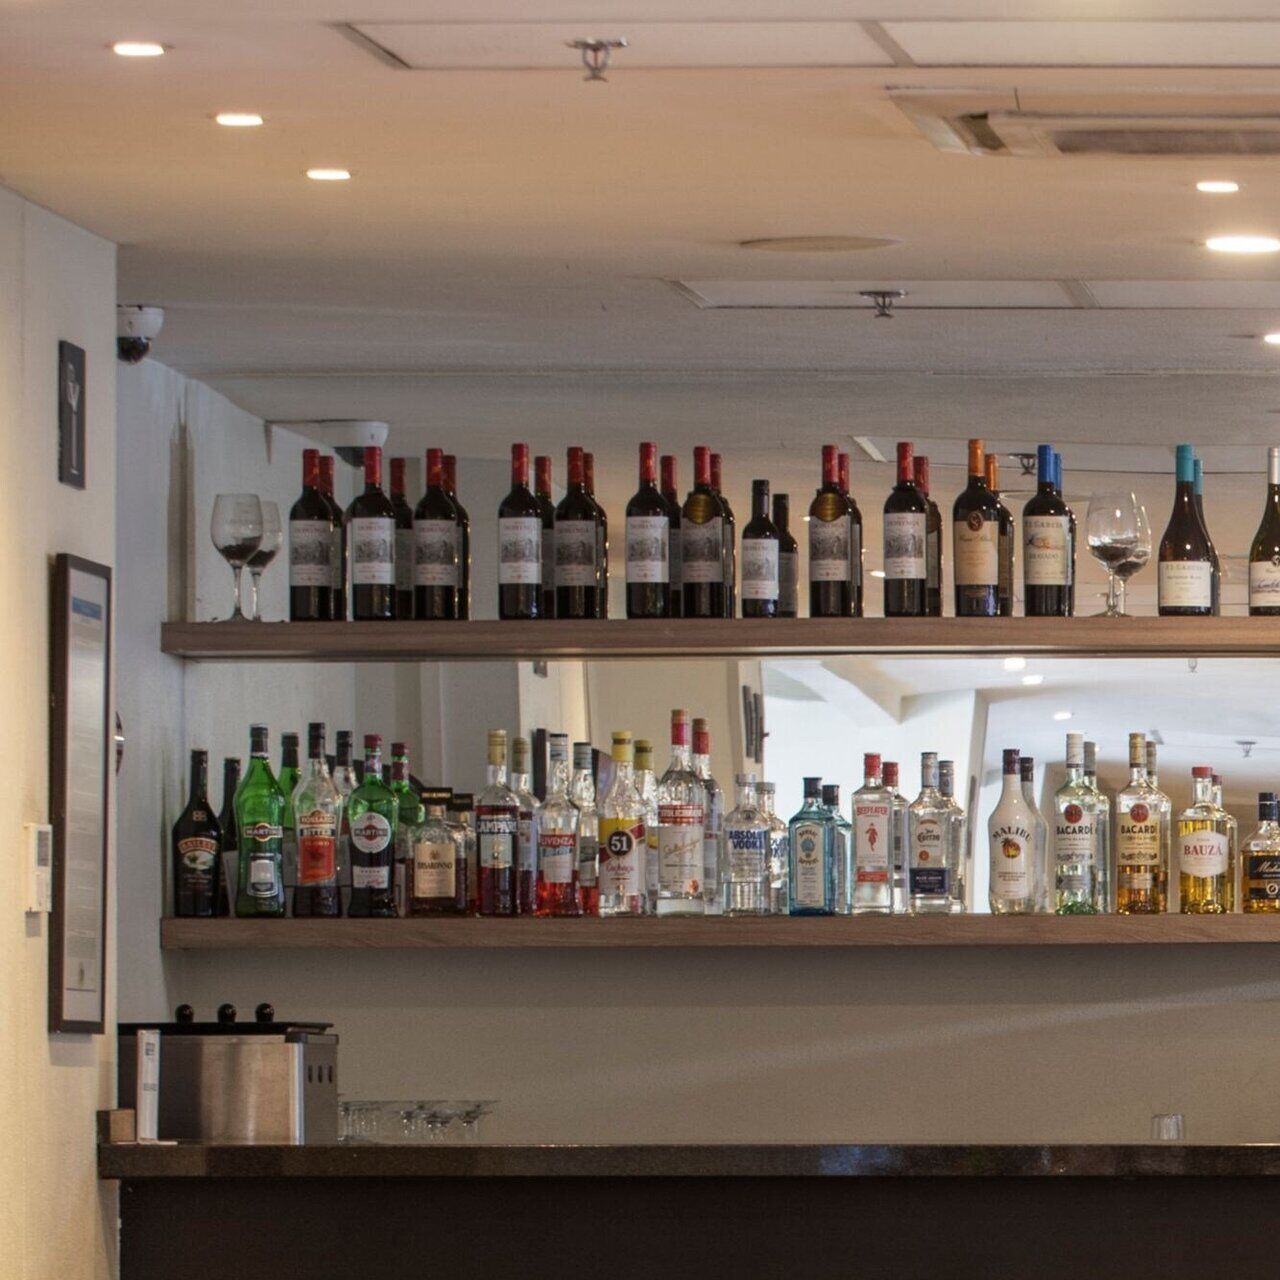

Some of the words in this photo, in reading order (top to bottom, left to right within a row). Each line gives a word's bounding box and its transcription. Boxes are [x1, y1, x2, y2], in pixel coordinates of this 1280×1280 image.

[991, 825, 1033, 843] MALIBU
[610, 835, 628, 852] 51
[1184, 843, 1223, 856] BAUZÁ
